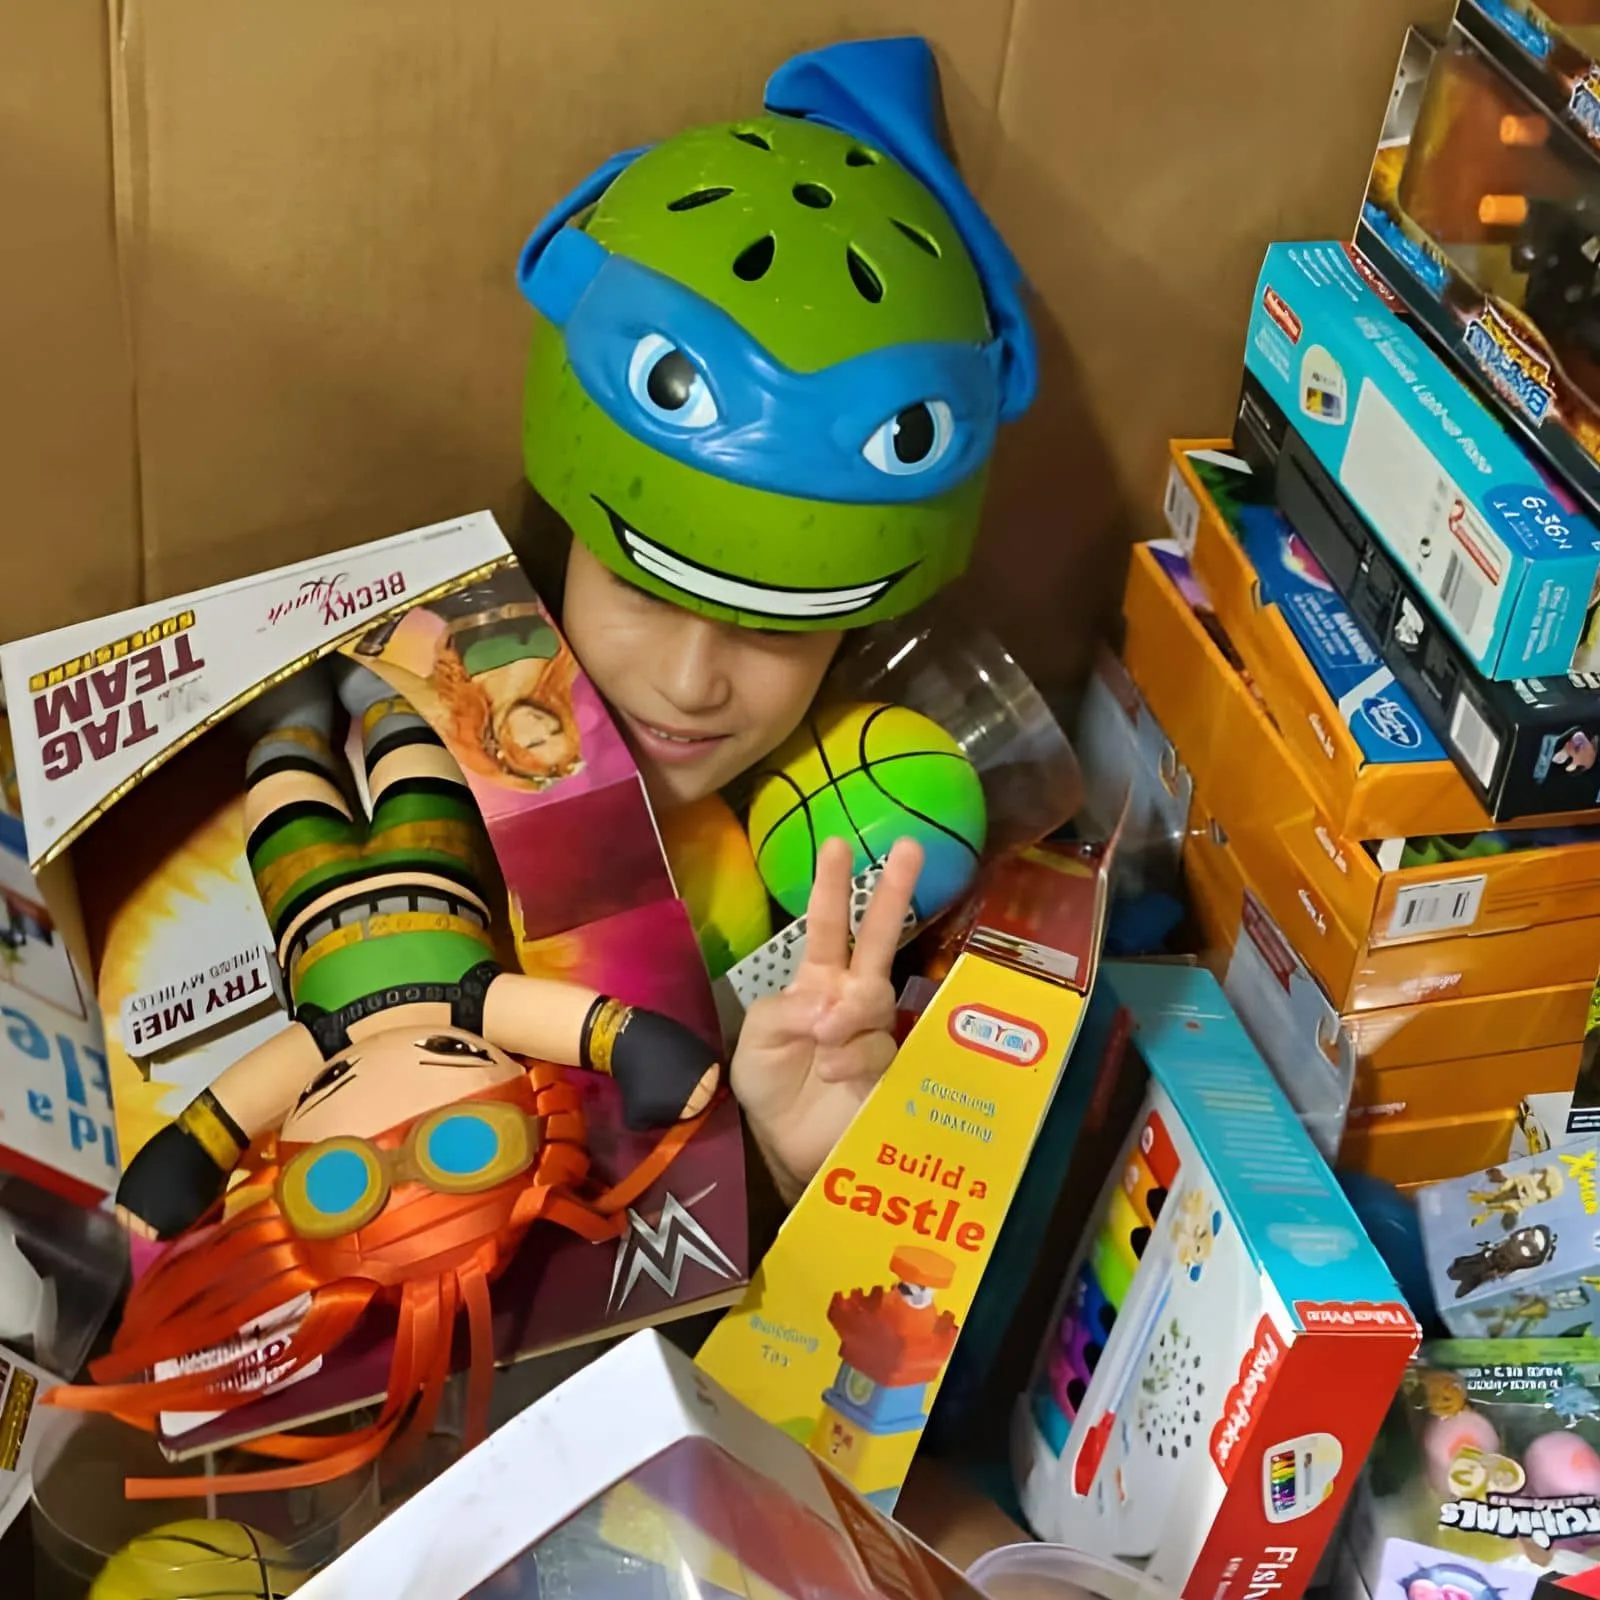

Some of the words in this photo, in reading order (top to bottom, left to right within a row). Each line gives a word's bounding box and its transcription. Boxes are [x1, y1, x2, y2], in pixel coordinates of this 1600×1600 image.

[324, 570, 406, 626] BECKY
[34, 634, 206, 738] TEAM
[42, 699, 159, 781] TAG
[206, 967, 268, 1014] TRY
[133, 999, 195, 1045] ME!
[876, 1142, 966, 1191] Build
[968, 1177, 988, 1199] a
[823, 1167, 986, 1253] Castle
